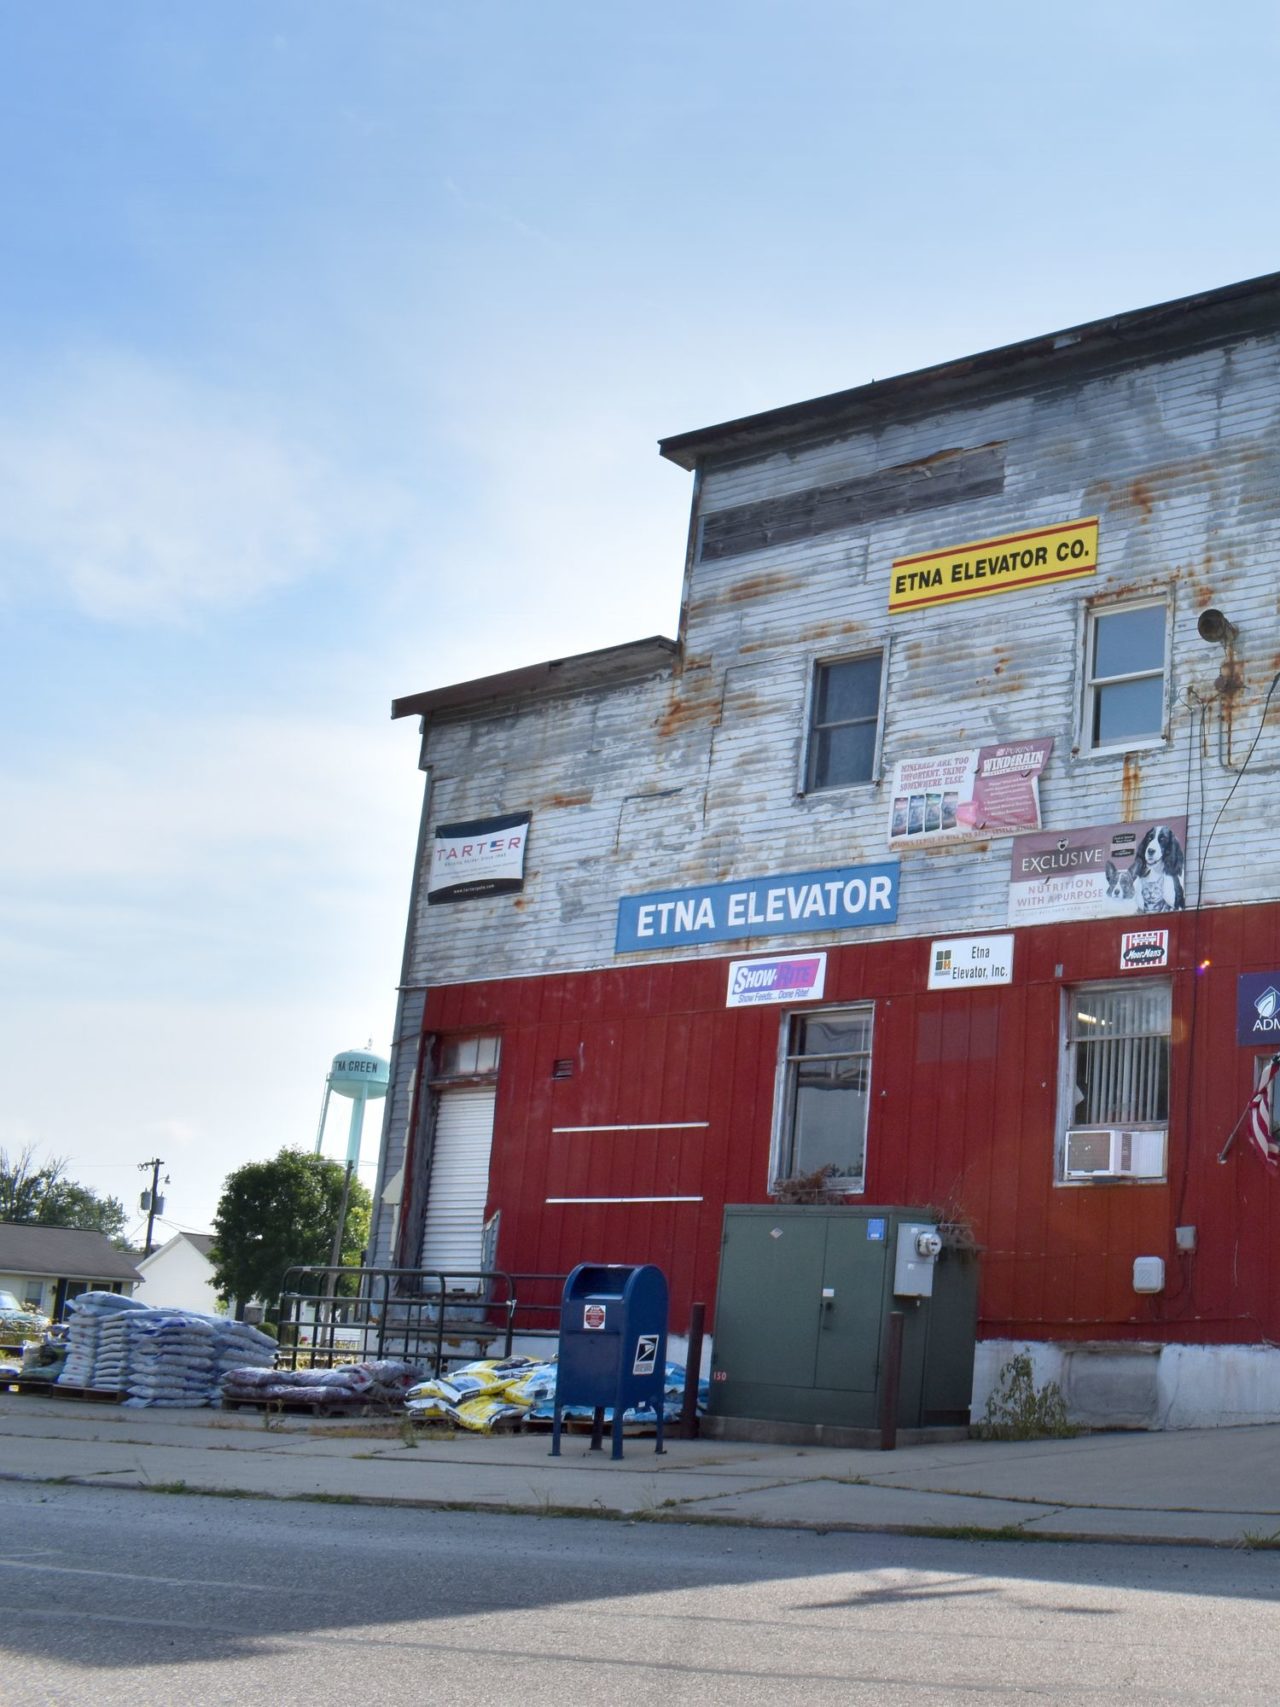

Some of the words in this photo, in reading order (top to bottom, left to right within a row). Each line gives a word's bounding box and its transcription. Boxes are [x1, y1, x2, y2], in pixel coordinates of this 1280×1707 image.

[895, 567, 943, 594] ETNA
[950, 546, 1048, 583] ELEVATOR
[1056, 539, 1090, 562] CO.
[954, 756, 969, 766] TOO
[942, 766, 967, 776] SKIMP
[900, 777, 942, 792] SOMEWHERE
[944, 775, 965, 784] ELSE.
[437, 837, 521, 861] TARTER
[1021, 848, 1103, 873] EXCLUSIVE
[1028, 879, 1094, 894] NUTRITION
[1017, 896, 1045, 907] WITH
[1056, 889, 1103, 903] PURPOSE
[637, 897, 716, 938] ETNA
[727, 875, 892, 927] ELEVATOR
[971, 946, 990, 959] Etna
[952, 964, 989, 980] Elevator,
[991, 963, 1008, 978] Inc.
[738, 992, 755, 1004] Show
[778, 990, 794, 999] Done
[348, 1060, 378, 1073] GREEN
[713, 1370, 727, 1382] 150
